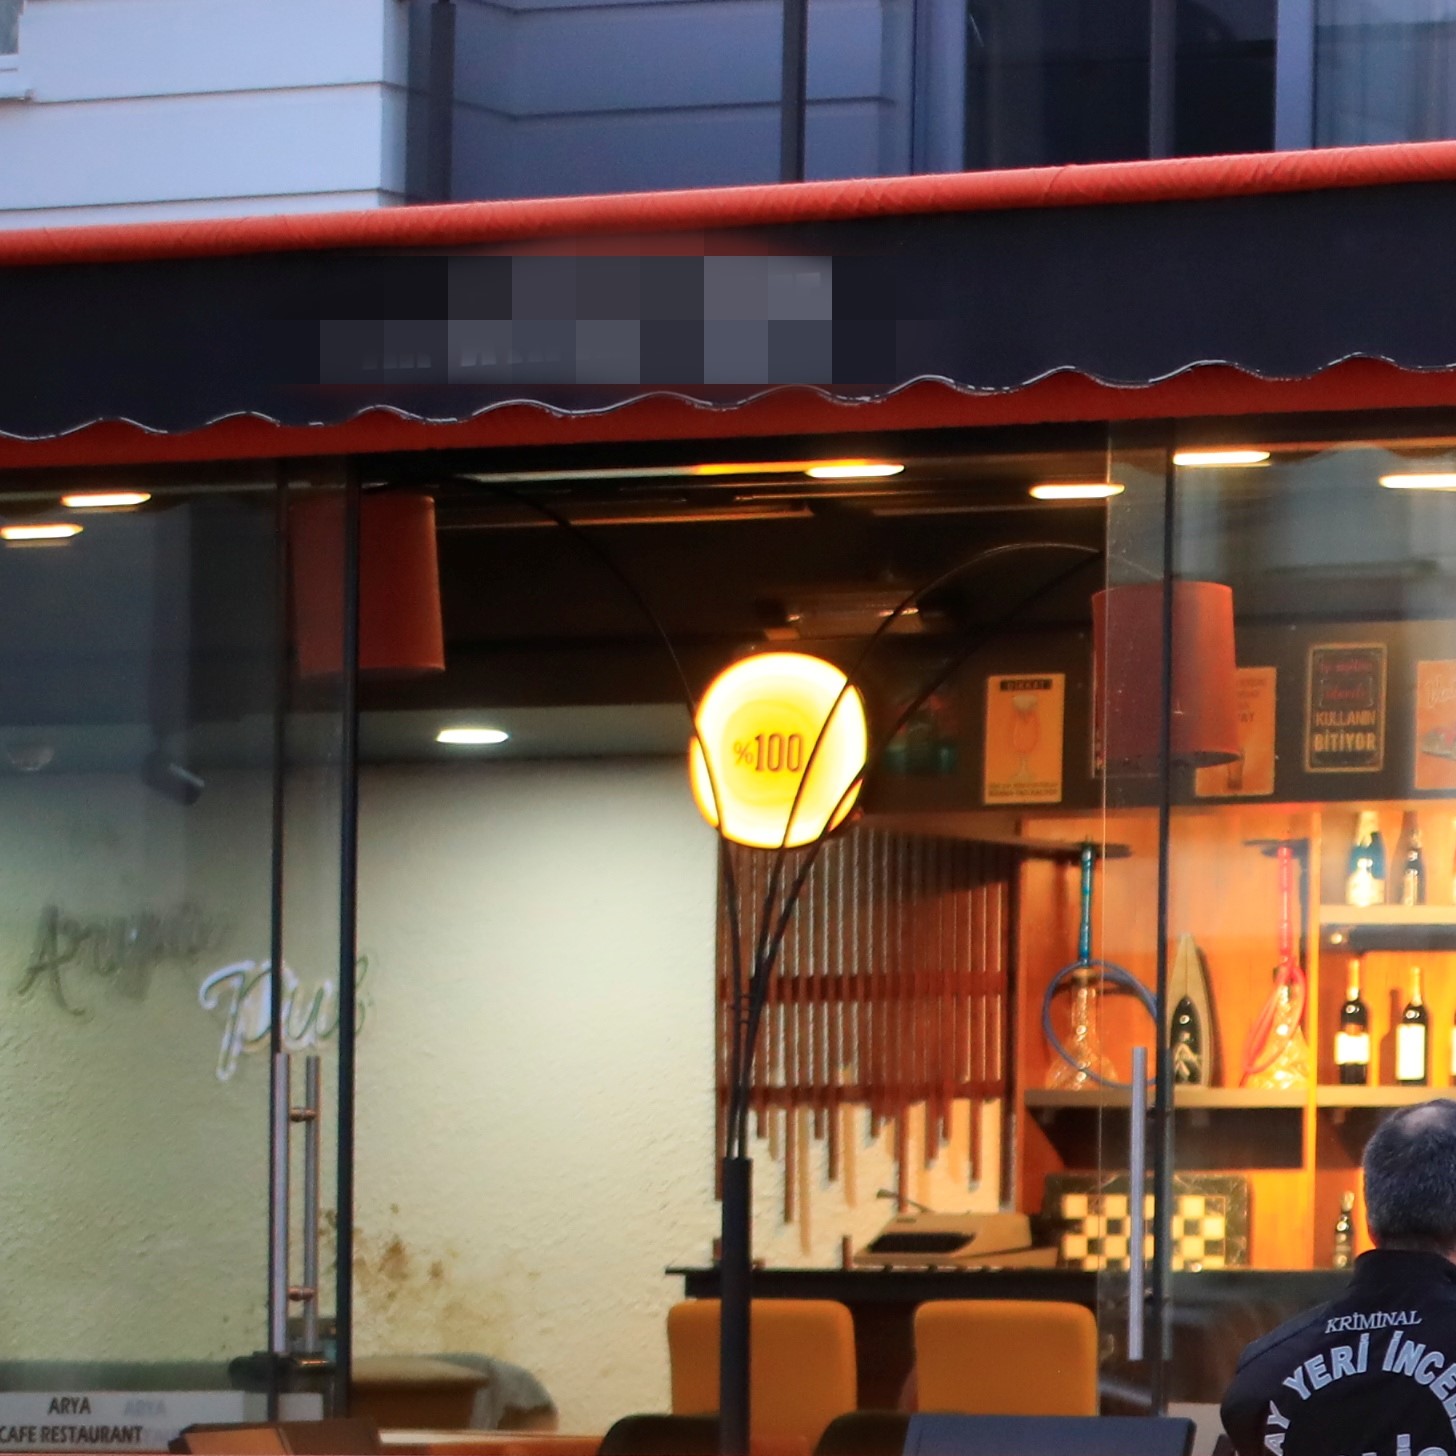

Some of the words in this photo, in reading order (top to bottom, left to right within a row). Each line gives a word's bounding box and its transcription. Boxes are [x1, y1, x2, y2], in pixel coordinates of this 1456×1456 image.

[1324, 1310, 1422, 1335] KRİMİNAL
[1282, 1332, 1370, 1401] YERİ
[48, 1397, 92, 1415] ARYA
[0, 1426, 37, 1444] CAFE
[41, 1425, 144, 1444] RESTAURANT
